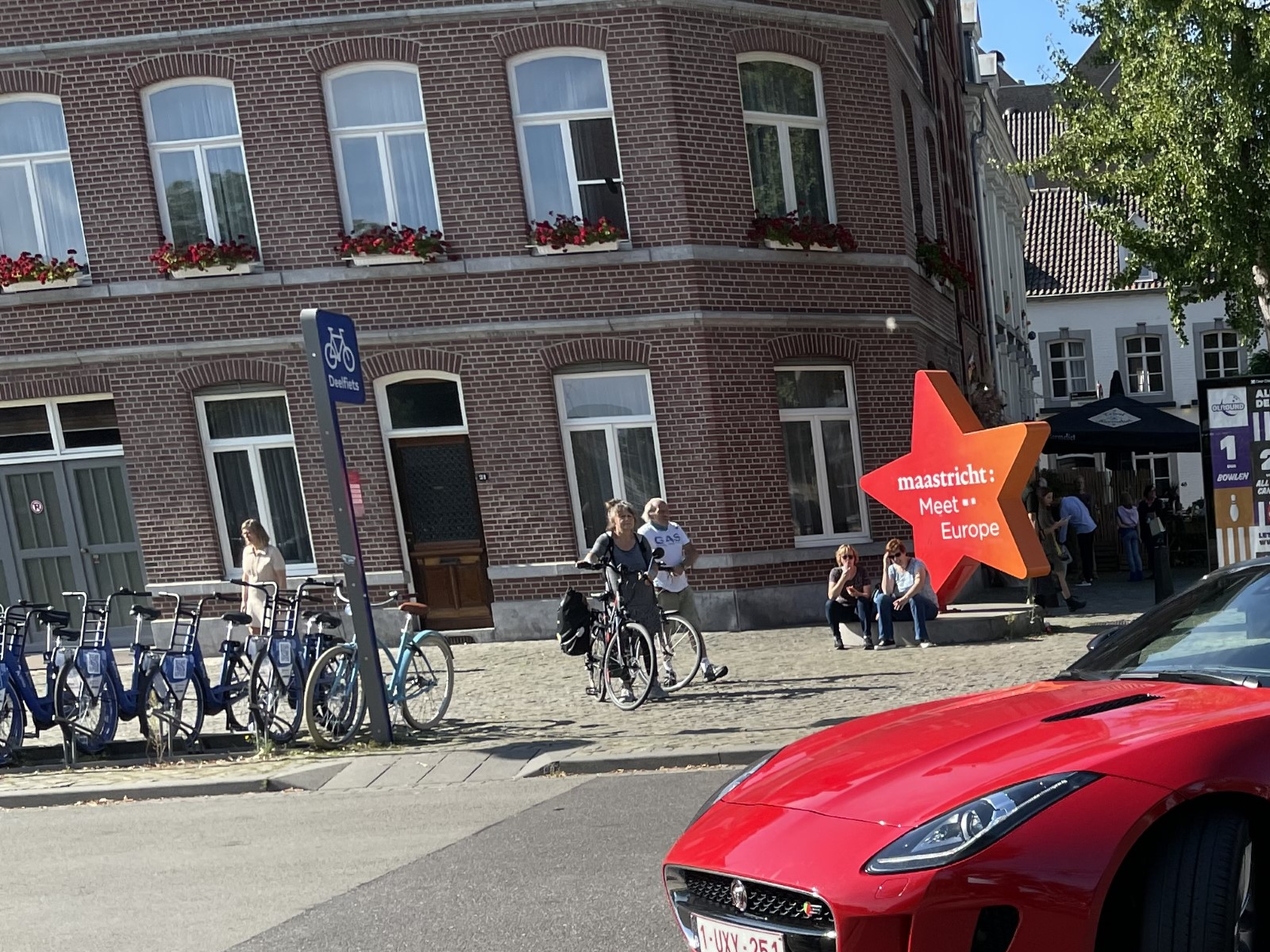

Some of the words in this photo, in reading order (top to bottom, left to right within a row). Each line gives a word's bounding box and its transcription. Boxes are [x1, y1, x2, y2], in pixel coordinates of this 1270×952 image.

[328, 374, 360, 391] Deelfiets
[1212, 403, 1245, 412] OLROUND
[1220, 435, 1236, 460] 1
[1216, 472, 1250, 482] BOWLEN
[1256, 479, 1269, 487] ALL
[1257, 487, 1270, 495] CAN
[919, 496, 959, 515] Meet
[941, 521, 1000, 541] Europe
[654, 532, 681, 544] GAS
